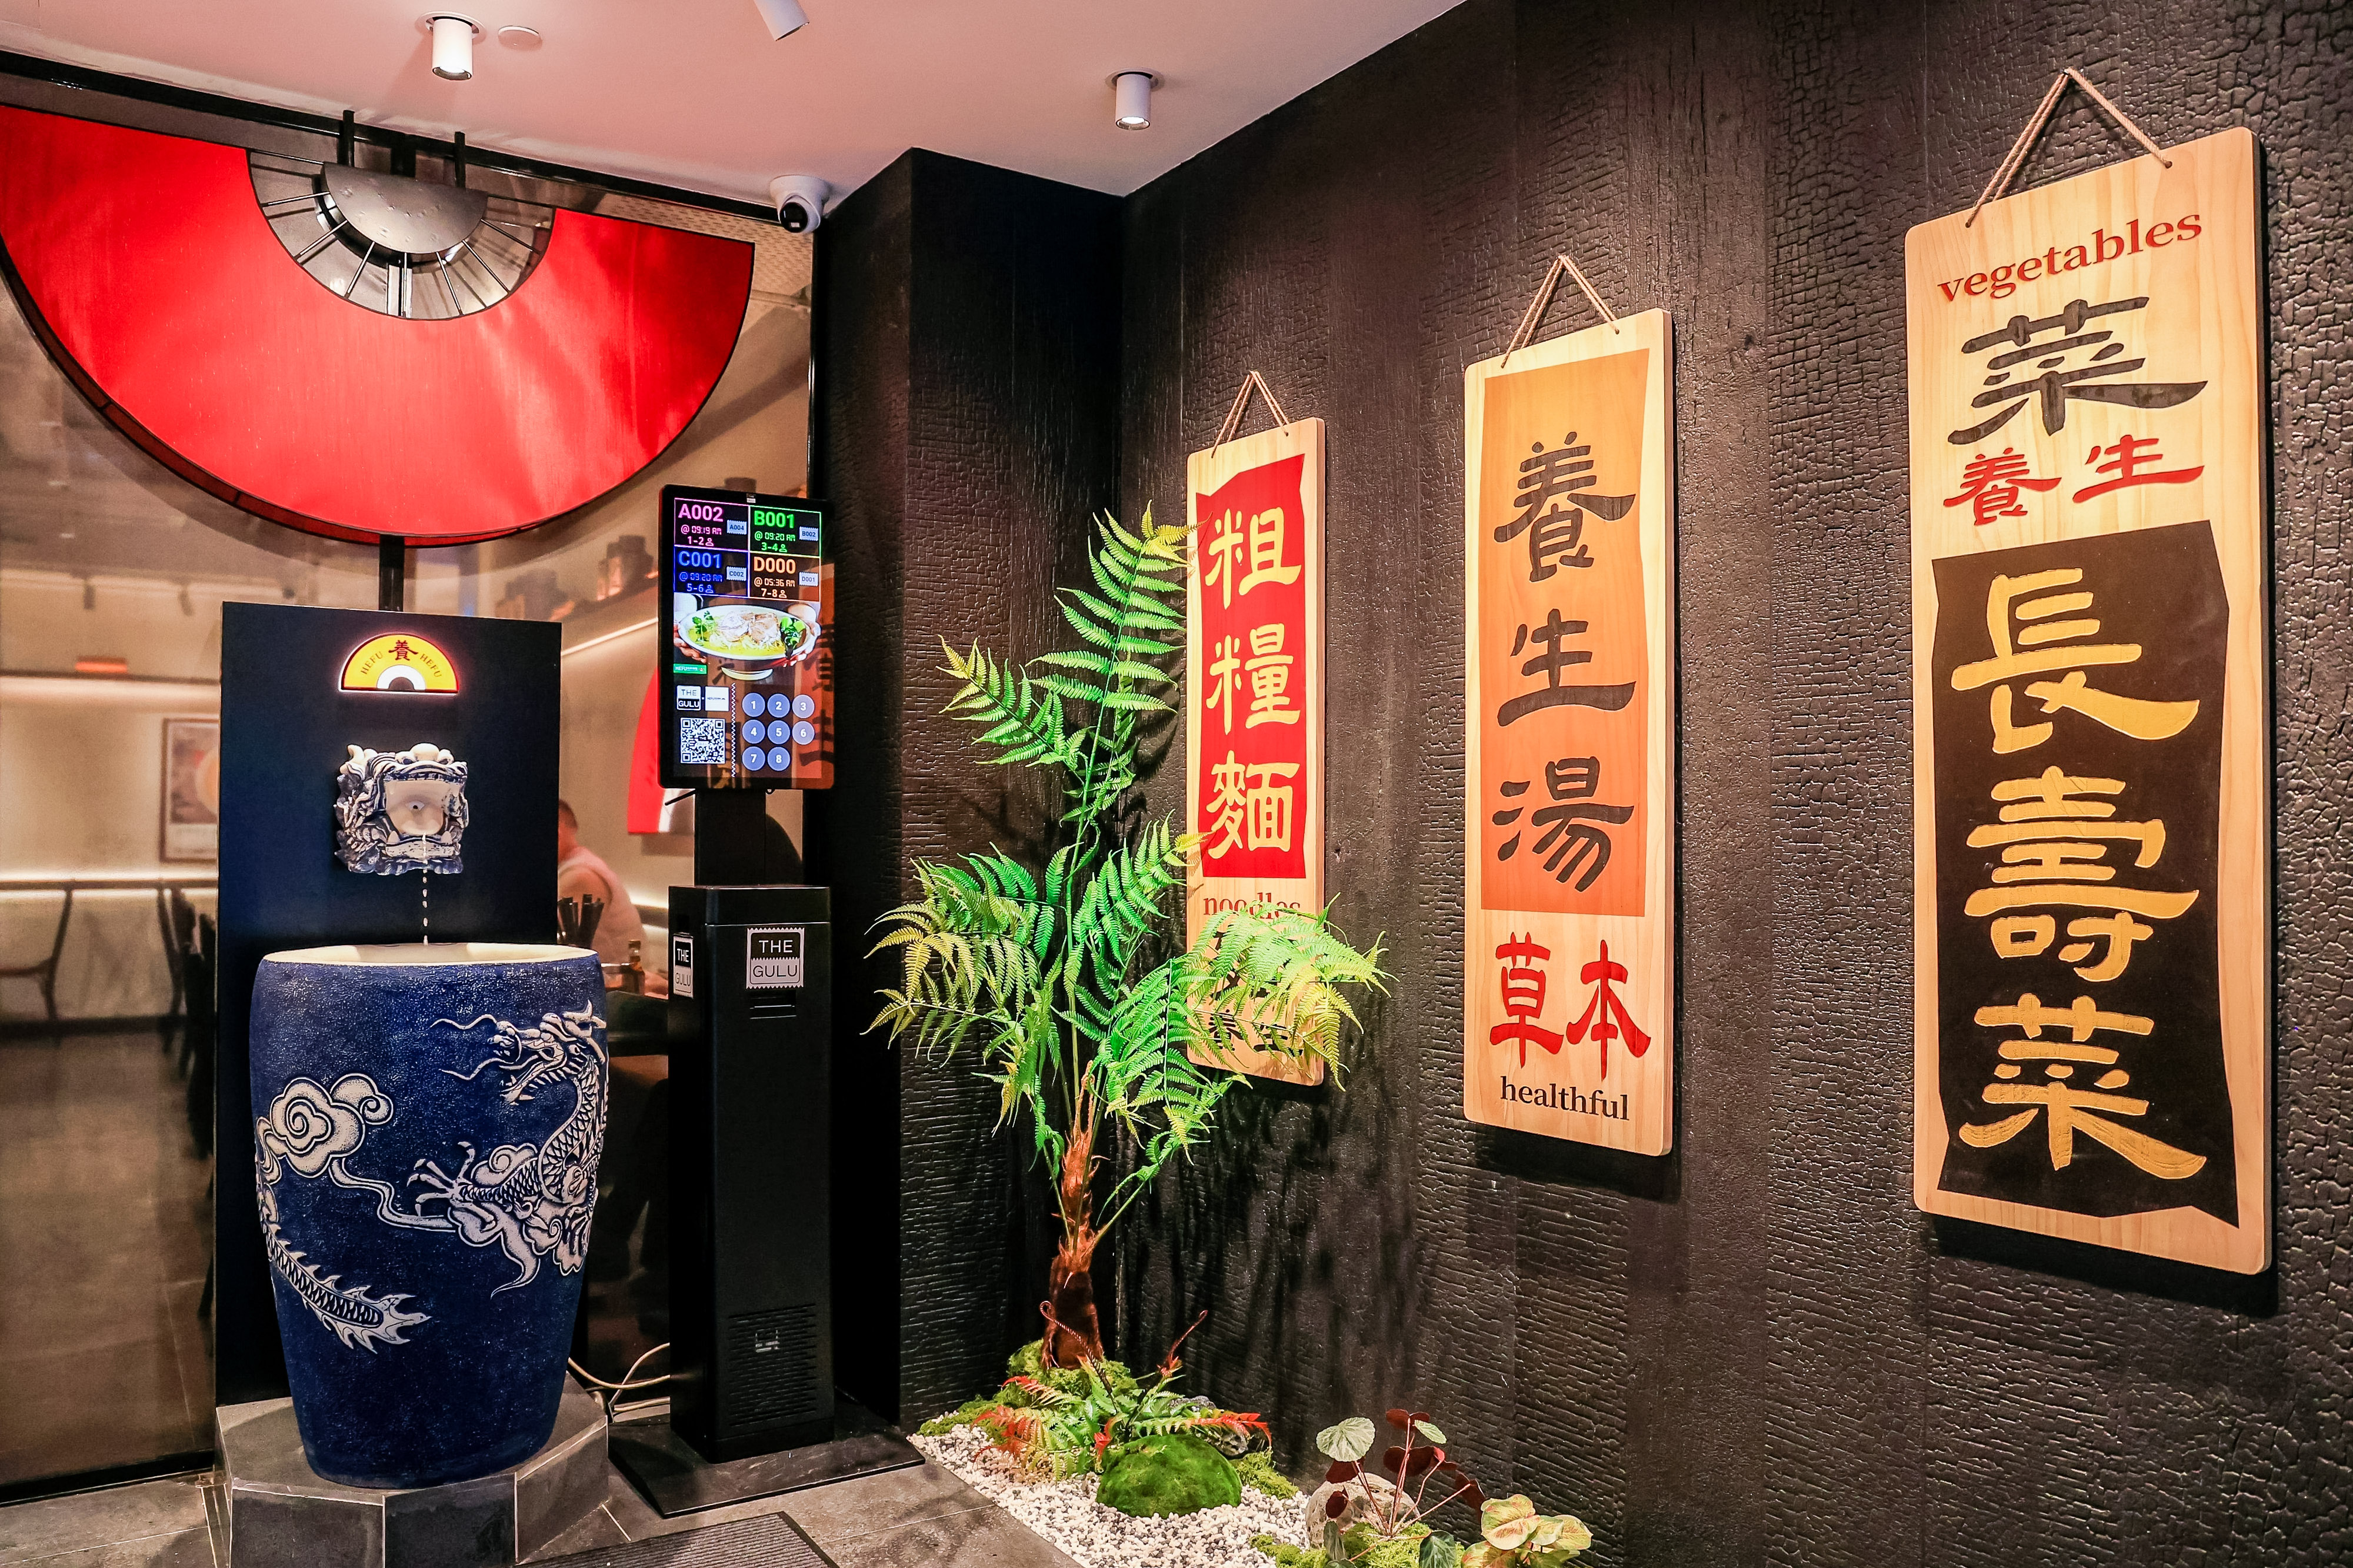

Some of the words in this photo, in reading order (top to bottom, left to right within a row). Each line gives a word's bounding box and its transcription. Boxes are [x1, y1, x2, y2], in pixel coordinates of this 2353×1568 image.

[1938, 212, 2202, 303] vegetables
[1948, 296, 2208, 444] 菜
[1944, 434, 2205, 526] 養生
[678, 503, 724, 522] A002
[754, 510, 794, 529] B001
[691, 525, 710, 535] 09:19
[765, 532, 785, 541] 09:20
[687, 536, 704, 545] 1-2
[761, 542, 778, 552] 3-4
[679, 551, 720, 569] C001
[754, 556, 796, 574] D000
[686, 583, 704, 592] 5-6
[764, 578, 785, 587] 05:36
[785, 579, 795, 588] AM
[761, 588, 778, 598] 7-8
[388, 639, 419, 661] 養
[361, 651, 383, 675] HEFU
[419, 653, 442, 678] HEFU
[1493, 431, 1637, 892] 養生湯
[1205, 507, 1301, 861] 粗糧麵
[751, 700, 756, 709] 1
[775, 701, 782, 710] 2
[800, 702, 806, 711] 3
[751, 727, 757, 736] 4
[775, 728, 782, 737] 5
[800, 728, 806, 738] 6
[751, 754, 757, 763] 7
[775, 754, 782, 763] 8
[1951, 568, 2207, 1179] 長壽菜
[758, 939, 793, 953] THE
[676, 948, 689, 963] THE
[675, 972, 691, 987] GULU
[752, 965, 798, 978] GULU
[1489, 931, 1652, 1082] 草本
[1499, 1074, 1629, 1121] healthful
